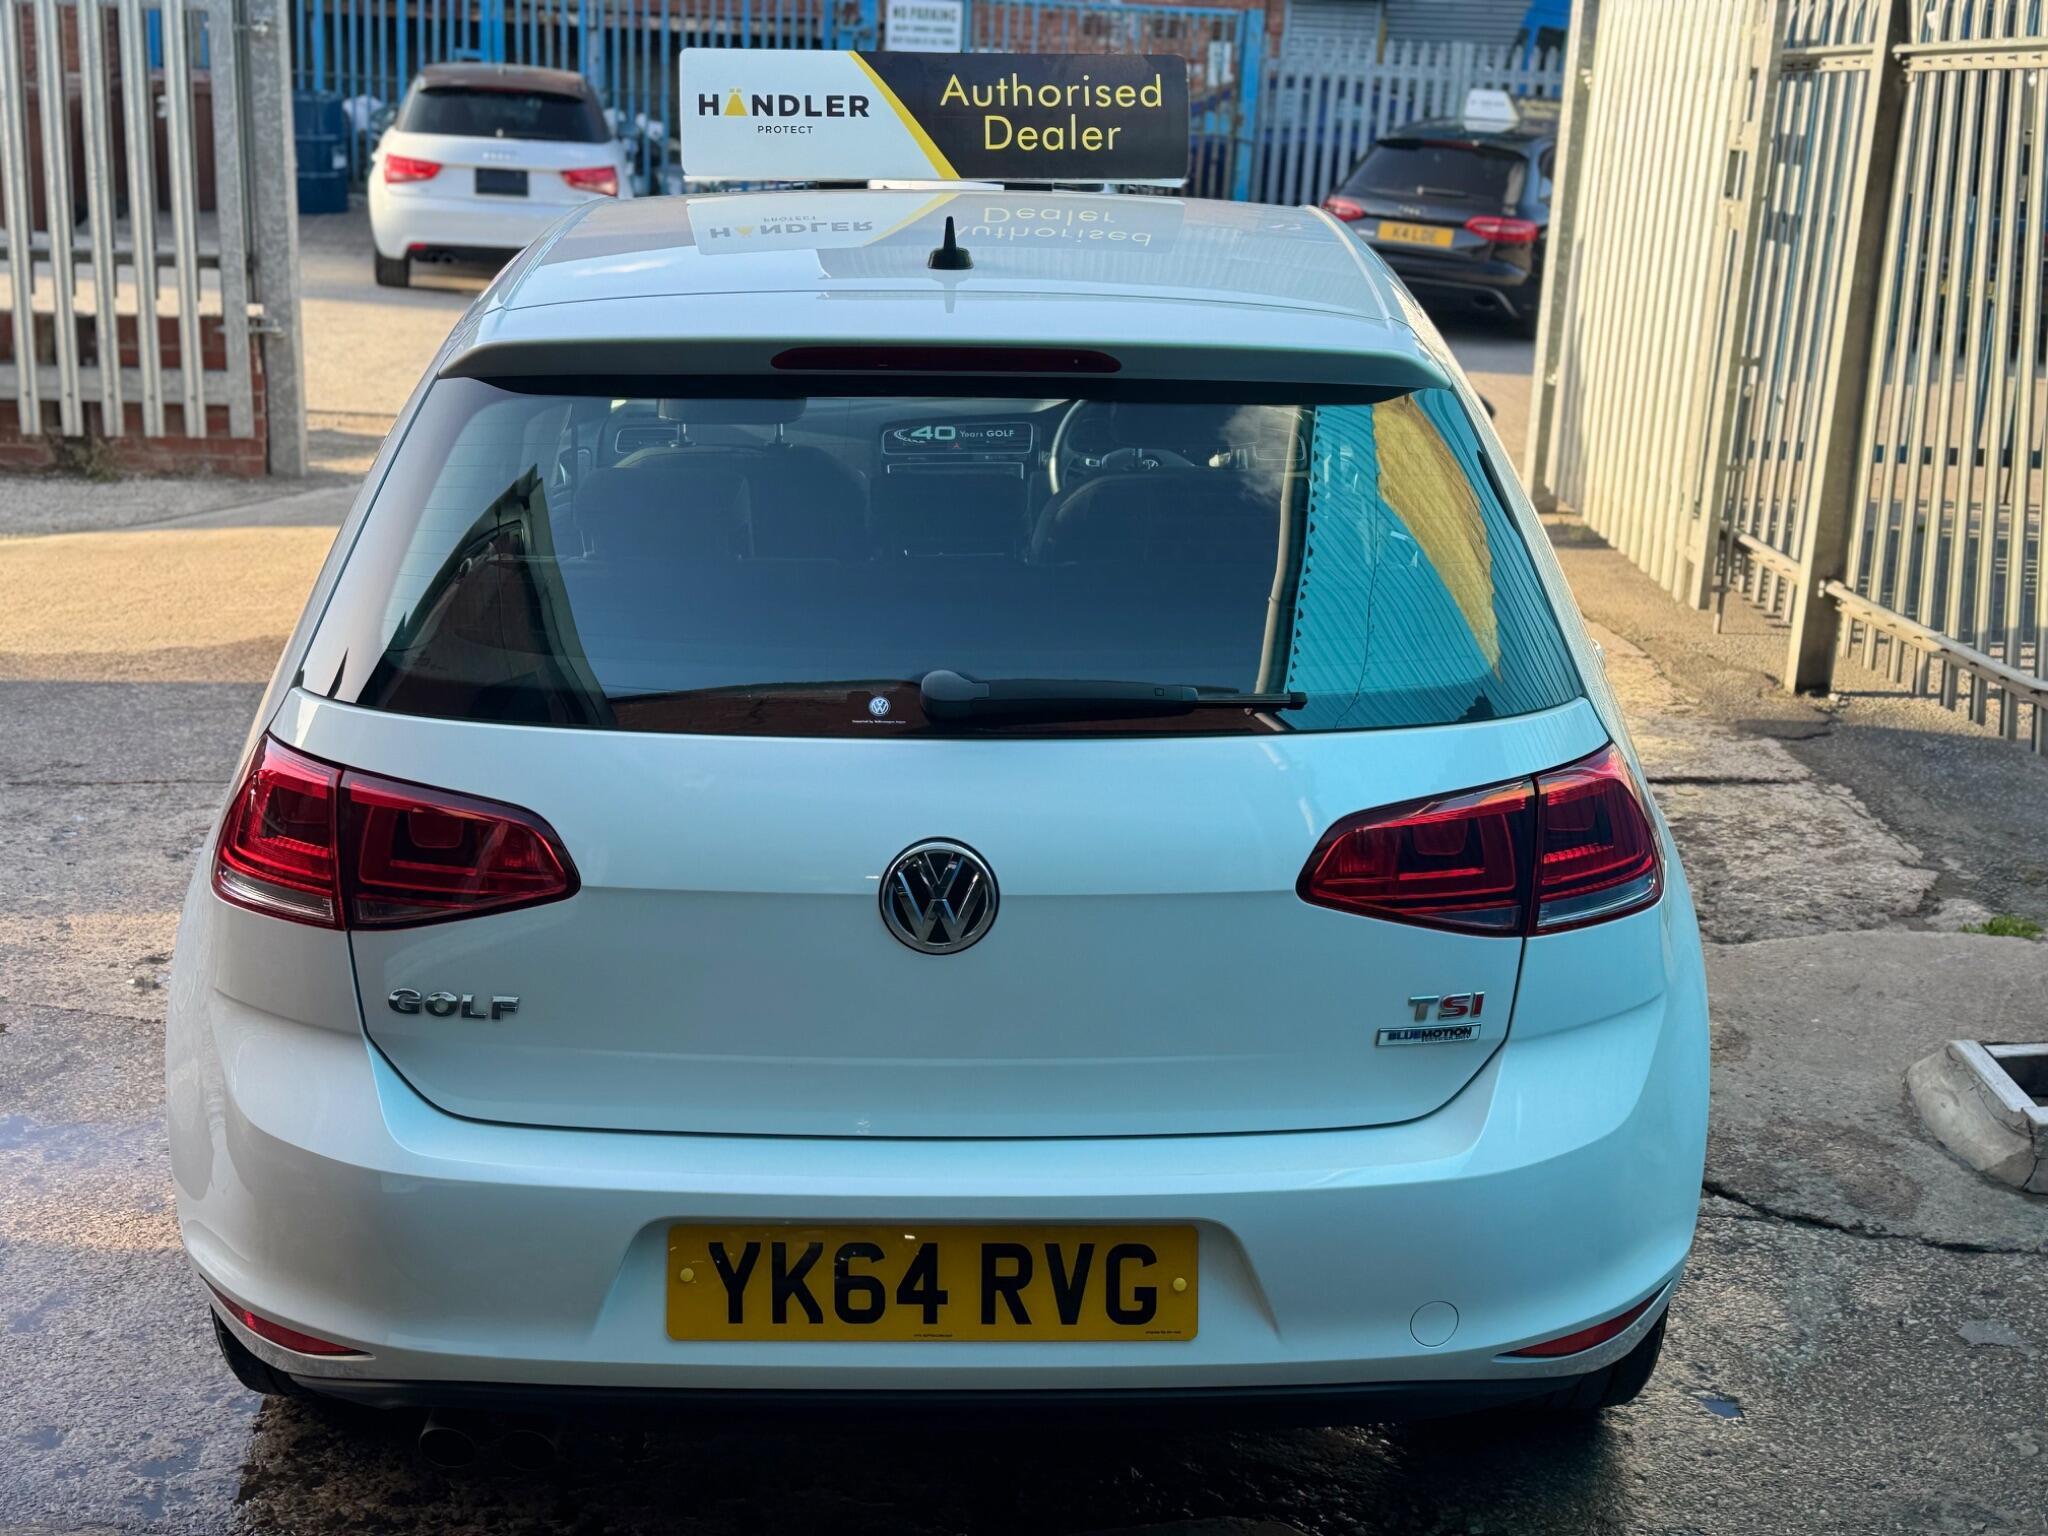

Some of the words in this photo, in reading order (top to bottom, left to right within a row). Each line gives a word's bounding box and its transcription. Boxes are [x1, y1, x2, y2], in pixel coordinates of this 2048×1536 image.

[939, 72, 1162, 107] Authorised
[757, 125, 814, 134] PROTECT
[984, 113, 1122, 150] Dealer
[910, 425, 956, 440] 40
[959, 429, 984, 438] Years
[985, 429, 1015, 437] GOLF
[388, 988, 520, 1020] GOLF
[1408, 991, 1485, 1022] TSI
[1387, 1026, 1473, 1041] BLUEMOTION
[708, 1241, 949, 1325] YK64
[980, 1242, 1158, 1326] RVG
